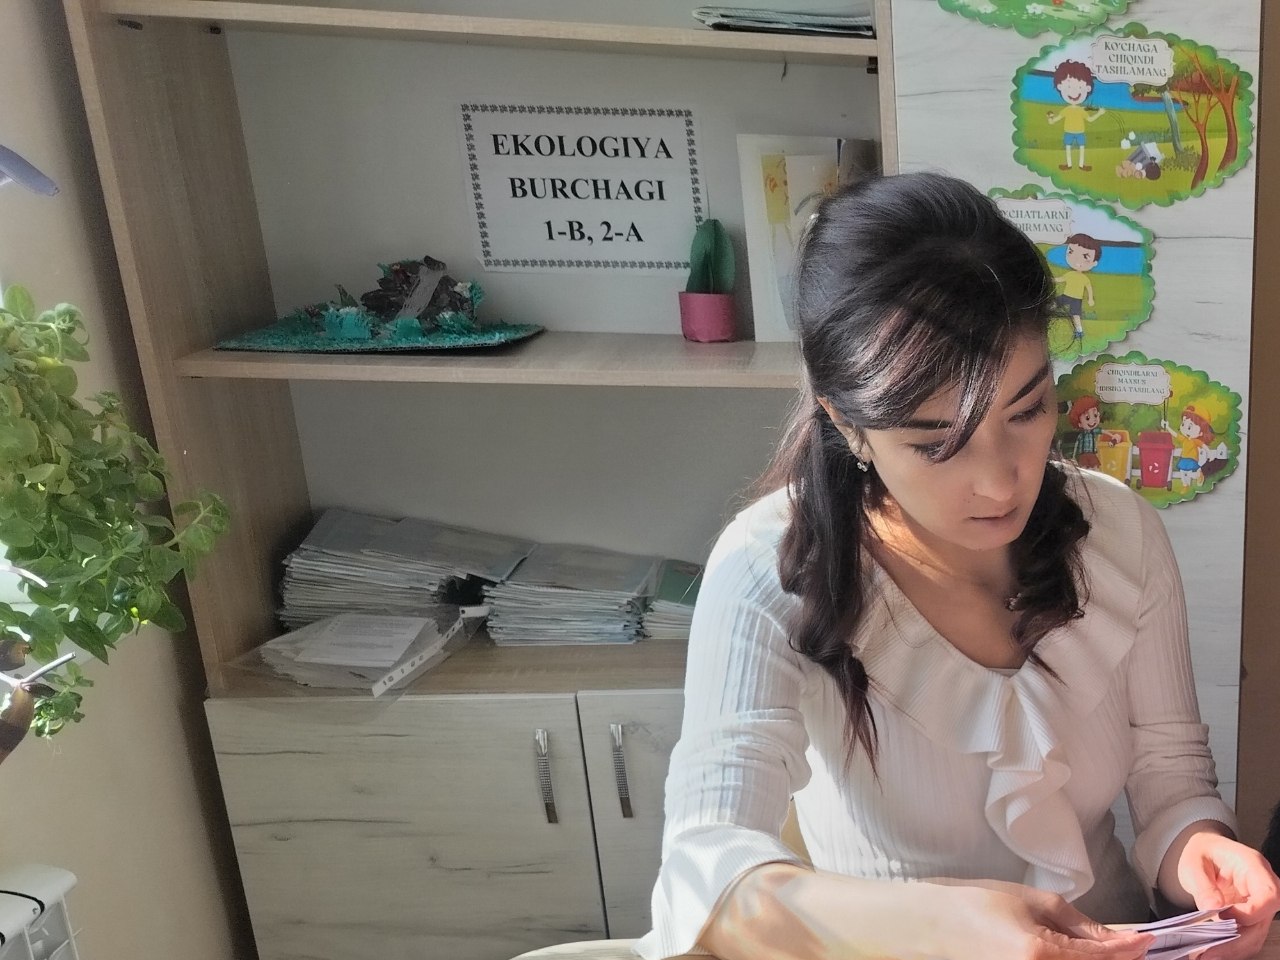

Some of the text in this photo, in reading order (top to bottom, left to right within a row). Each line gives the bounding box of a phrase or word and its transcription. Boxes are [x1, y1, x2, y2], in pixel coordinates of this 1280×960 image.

[1104, 41, 1158, 53] KO'CHAGA
[1108, 54, 1154, 65] CHIQINDI
[1096, 64, 1167, 77] TASHLAMANG
[490, 133, 674, 159] EKOLOGIYA
[509, 177, 666, 201] BURCHAGI
[544, 220, 644, 246] 1-B, 2-A
